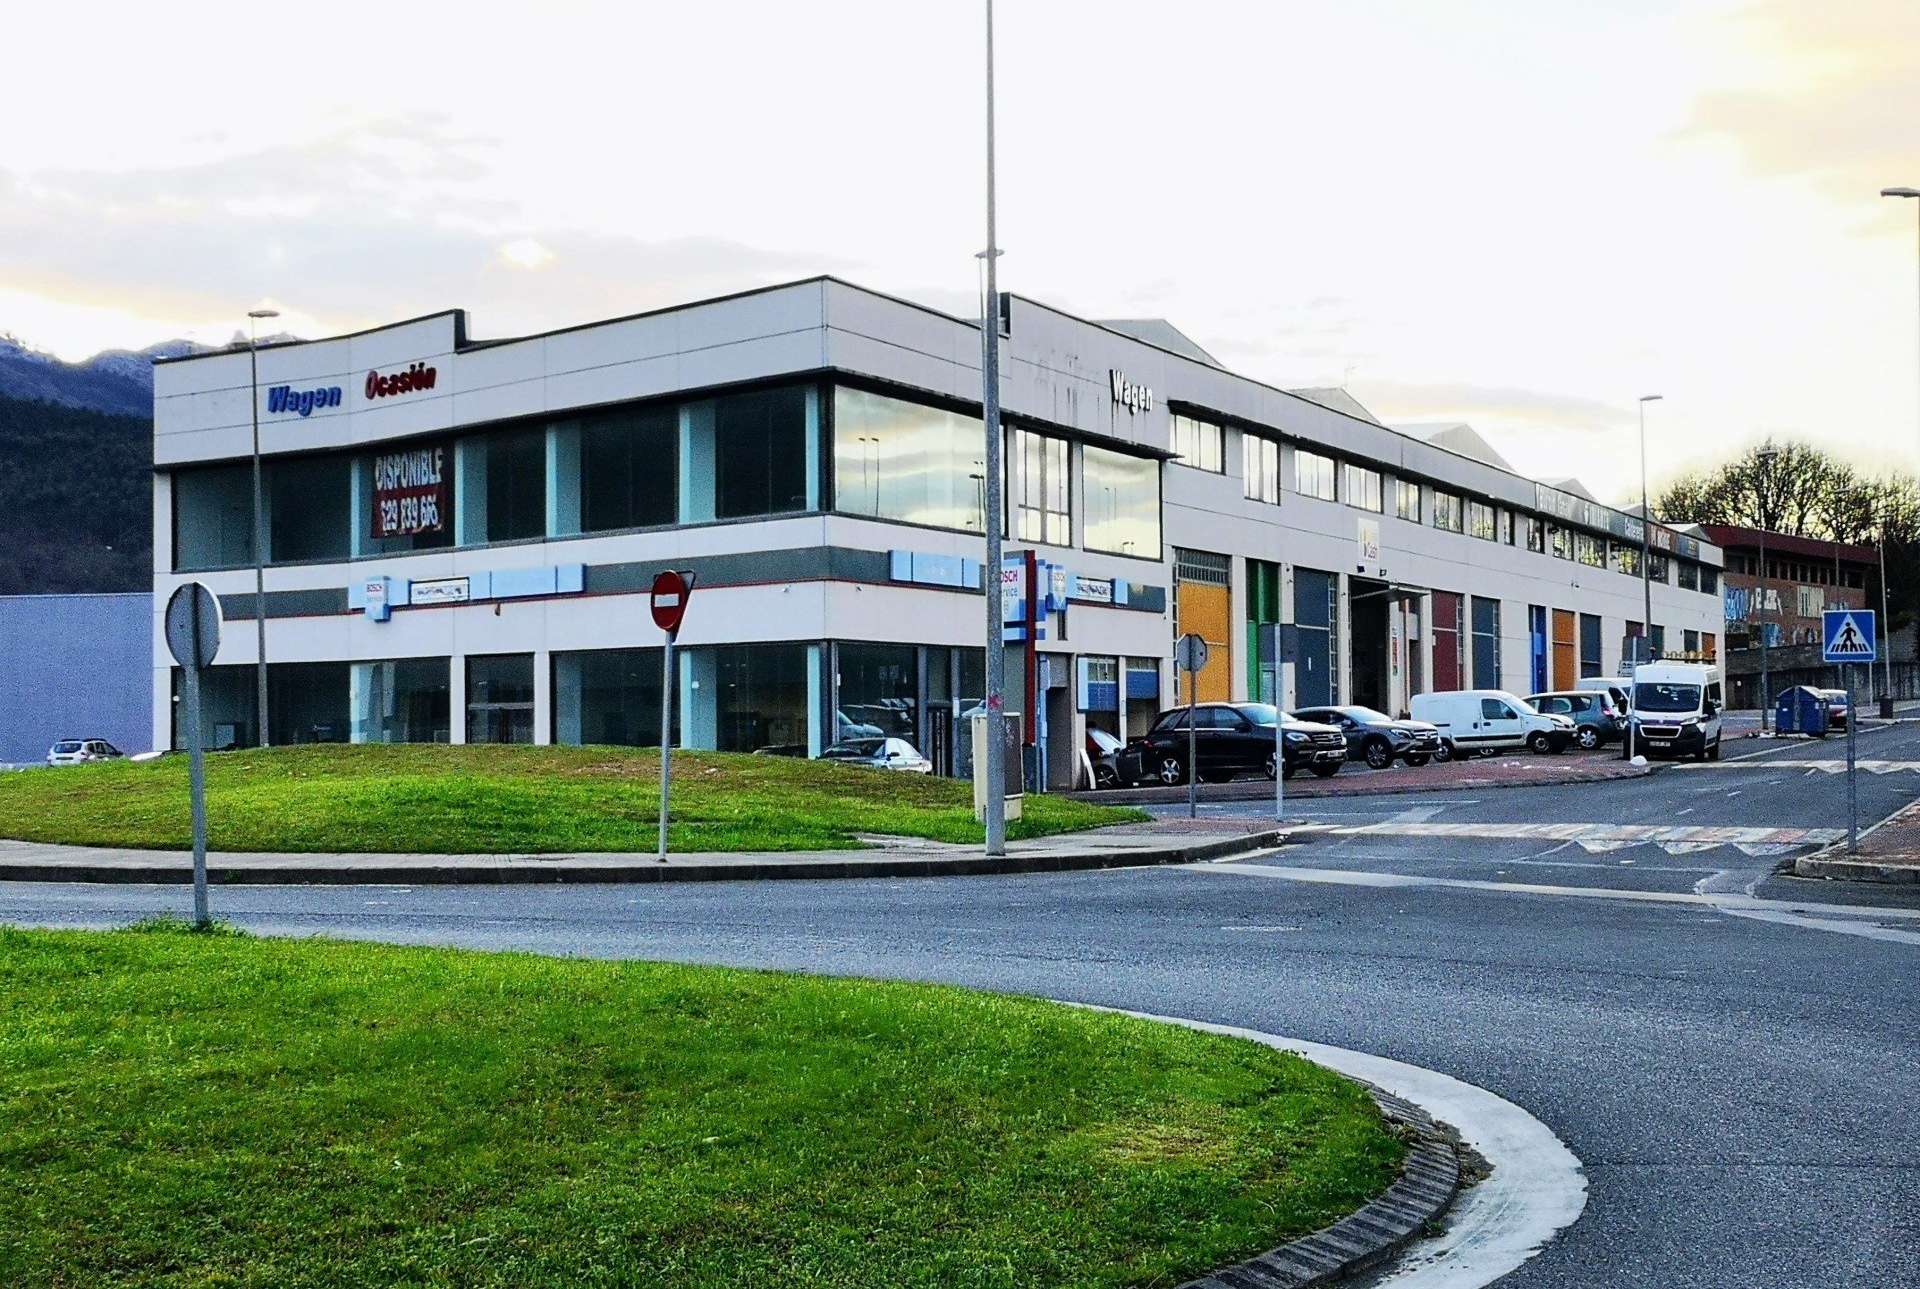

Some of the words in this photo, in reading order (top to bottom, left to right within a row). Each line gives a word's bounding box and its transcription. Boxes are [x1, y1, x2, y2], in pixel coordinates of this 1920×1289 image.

[365, 362, 437, 400] Ocasión
[1109, 369, 1153, 416] Wagen
[268, 385, 342, 417] Wagen
[375, 447, 443, 491] DISPONIBLE
[1000, 569, 1018, 583] OSCH
[1002, 587, 1018, 597] rvice
